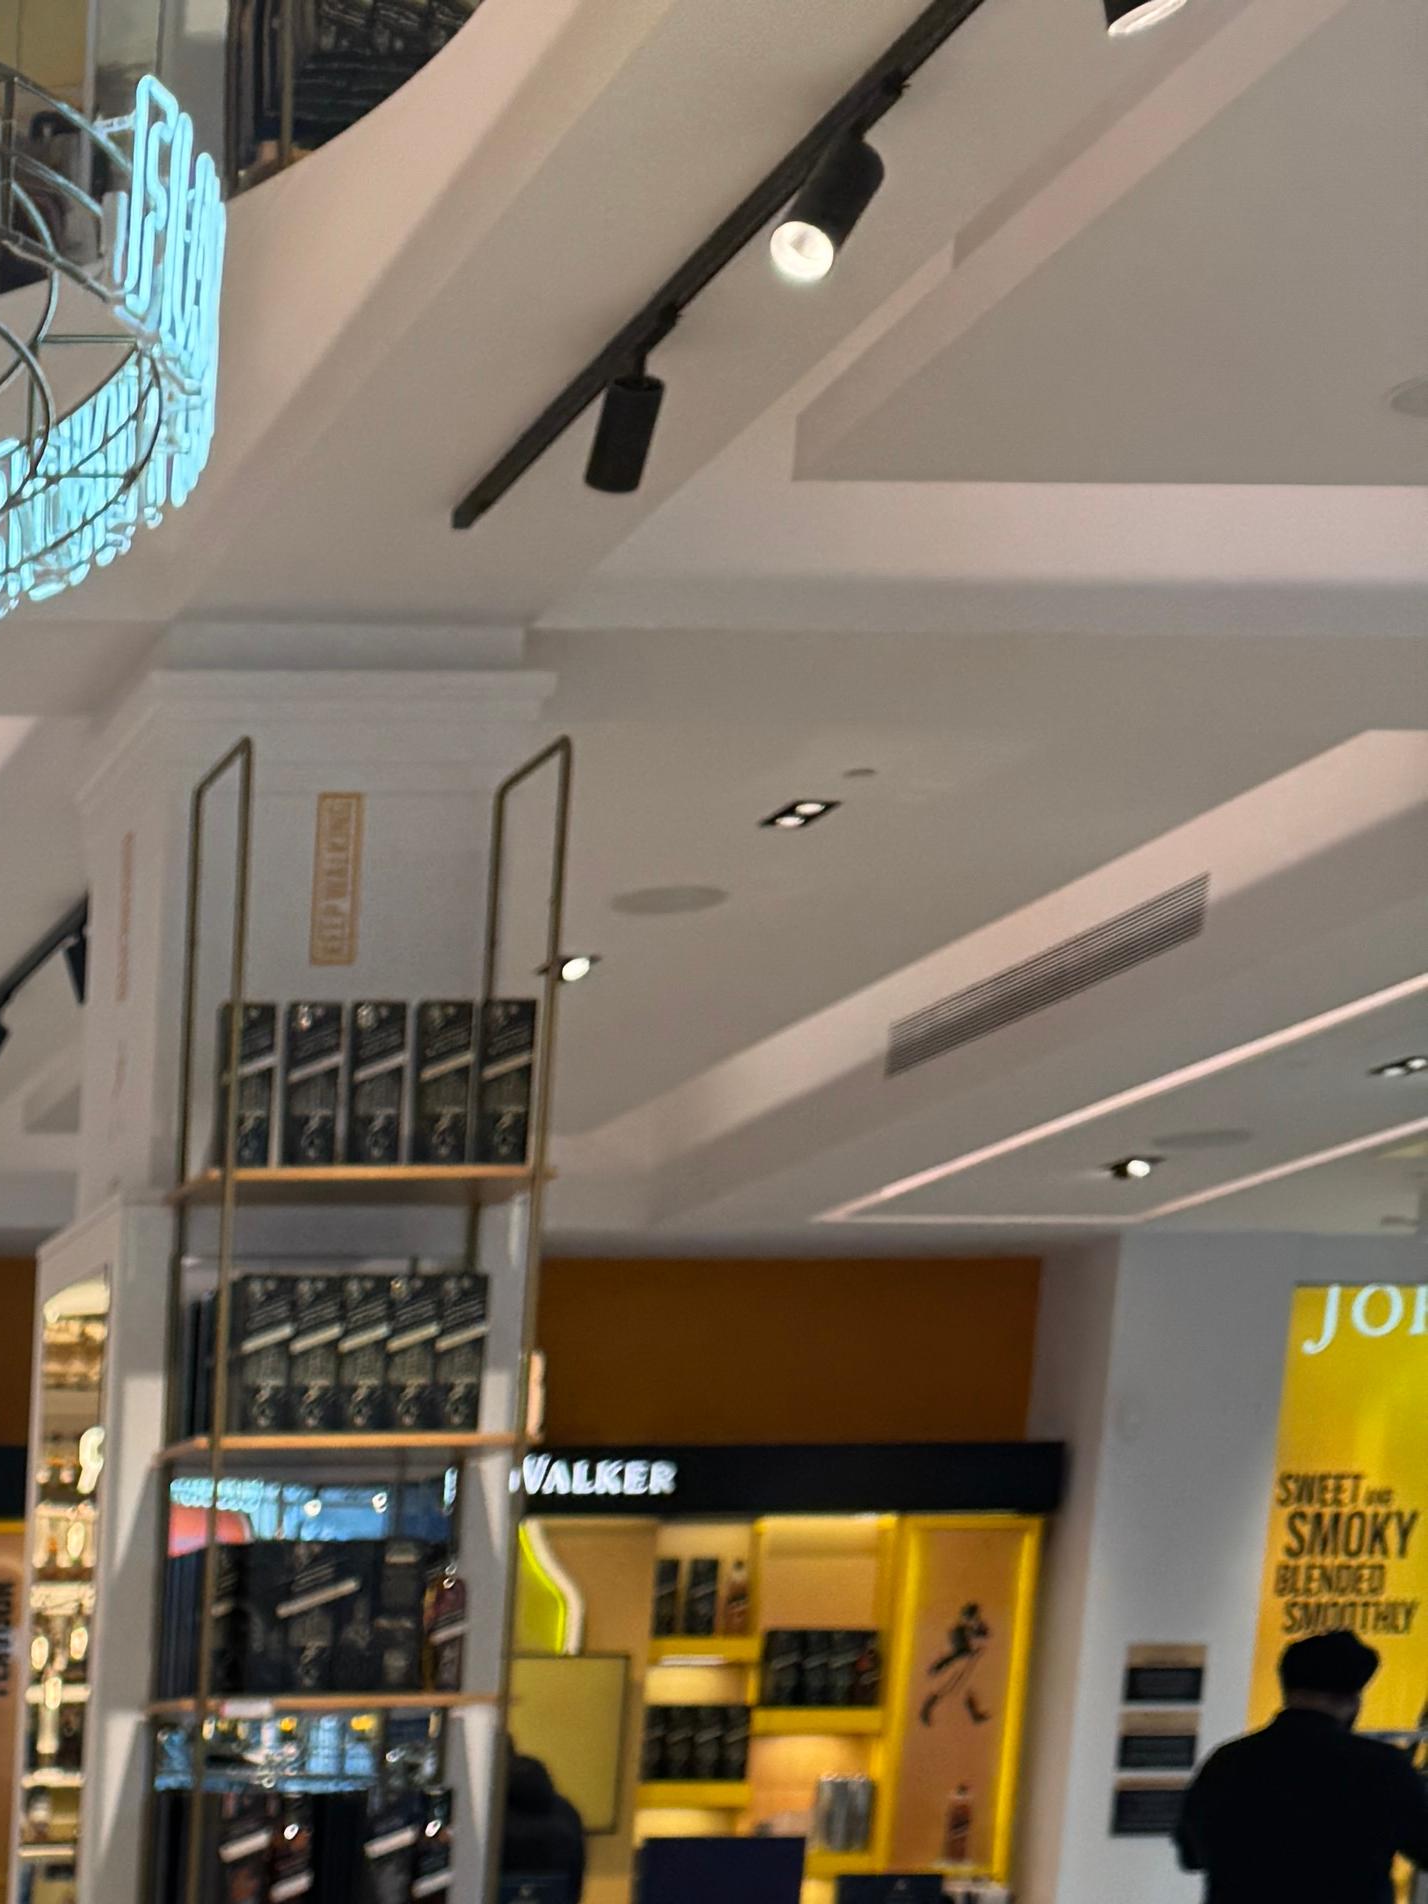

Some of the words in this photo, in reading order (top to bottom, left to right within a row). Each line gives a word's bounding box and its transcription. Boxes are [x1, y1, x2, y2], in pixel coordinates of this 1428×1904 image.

[1301, 1283, 1428, 1355] JO
[1277, 1473, 1363, 1508] SWEET
[1285, 1510, 1418, 1560] SMOKY
[1275, 1564, 1386, 1598] BLENDED
[1282, 1601, 1417, 1635] SMOOTHLY
